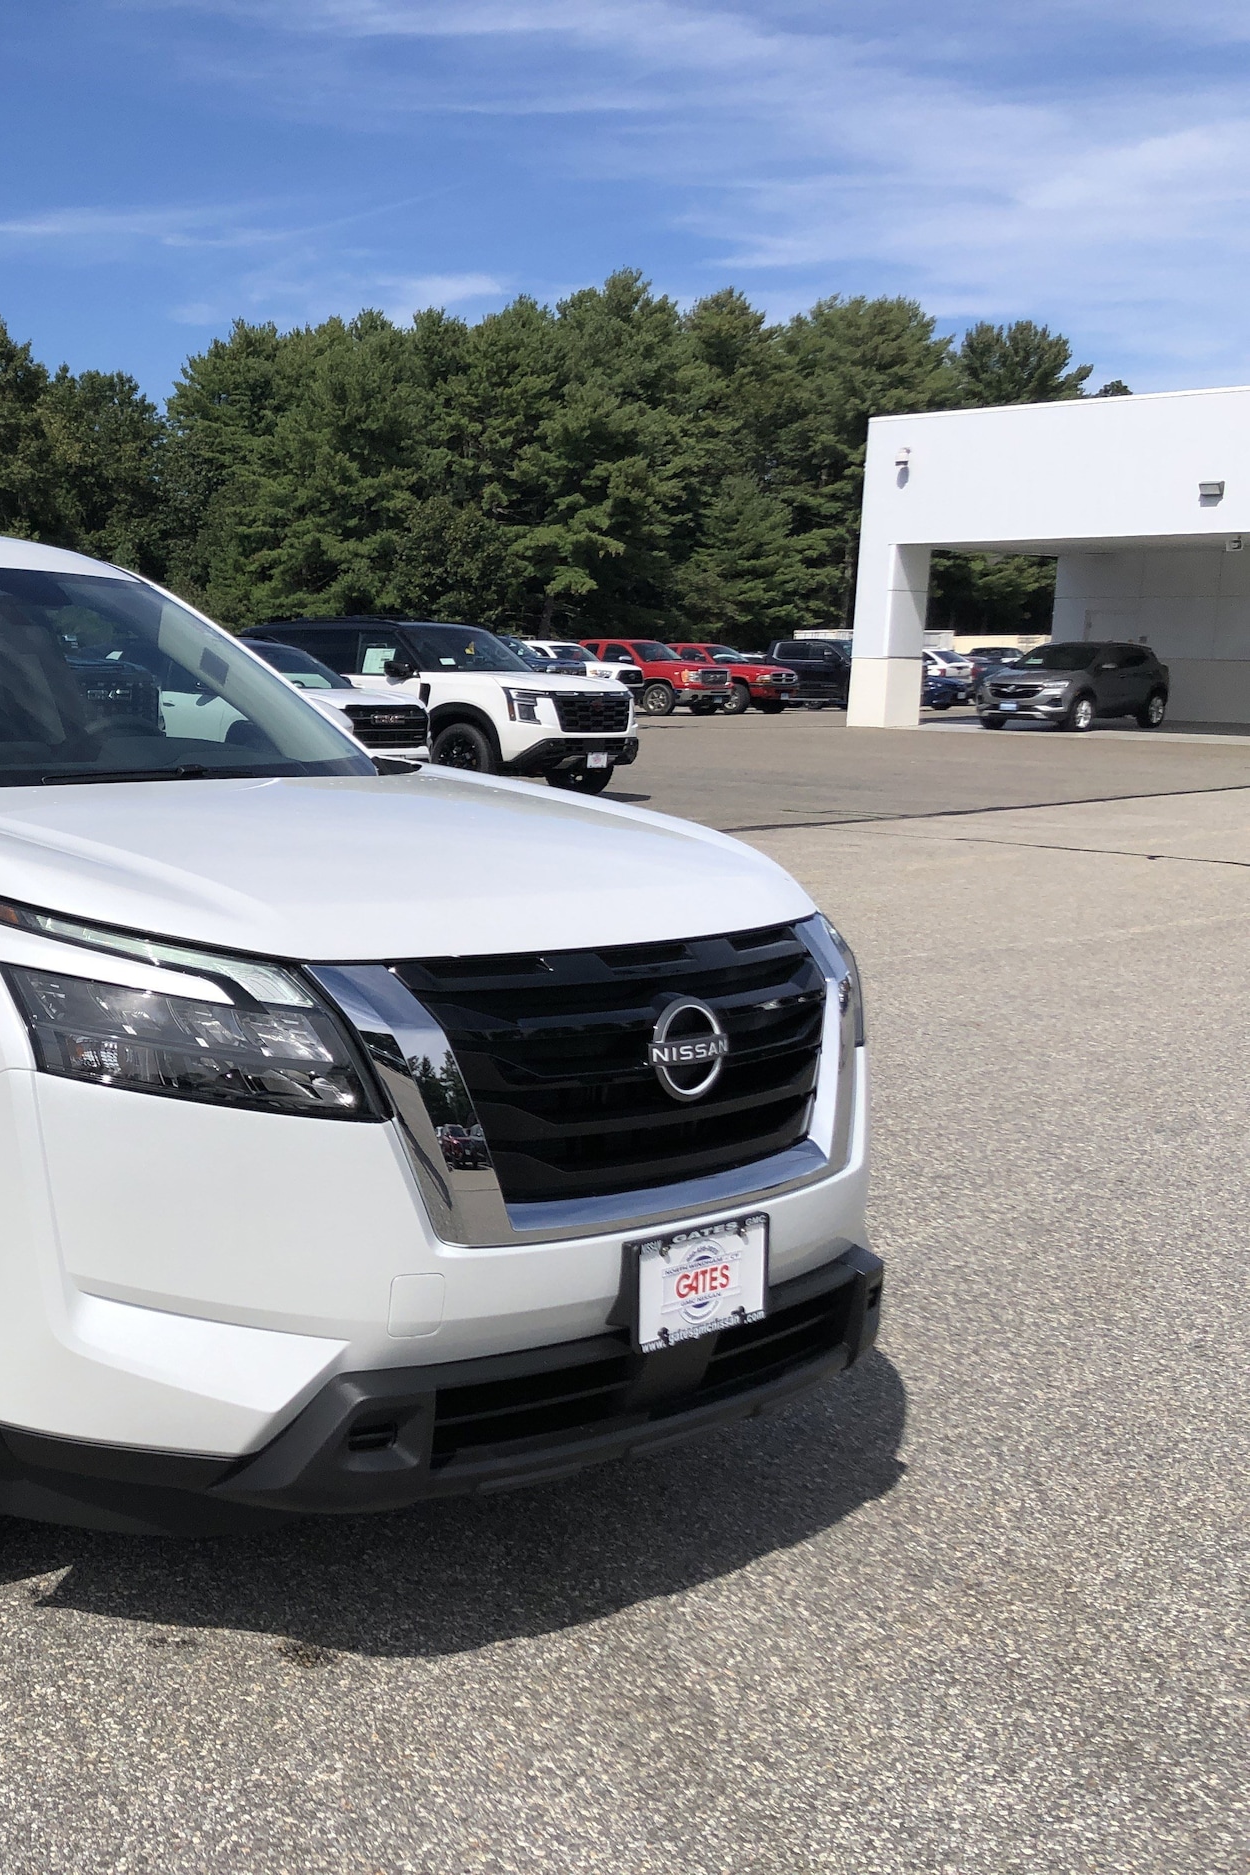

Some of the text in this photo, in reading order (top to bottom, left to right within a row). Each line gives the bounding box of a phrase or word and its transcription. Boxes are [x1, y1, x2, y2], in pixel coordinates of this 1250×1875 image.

[652, 1038, 728, 1063] NISSAN
[672, 1221, 738, 1243] GATES
[745, 1214, 767, 1227] GMC
[676, 1264, 730, 1299] GATES
